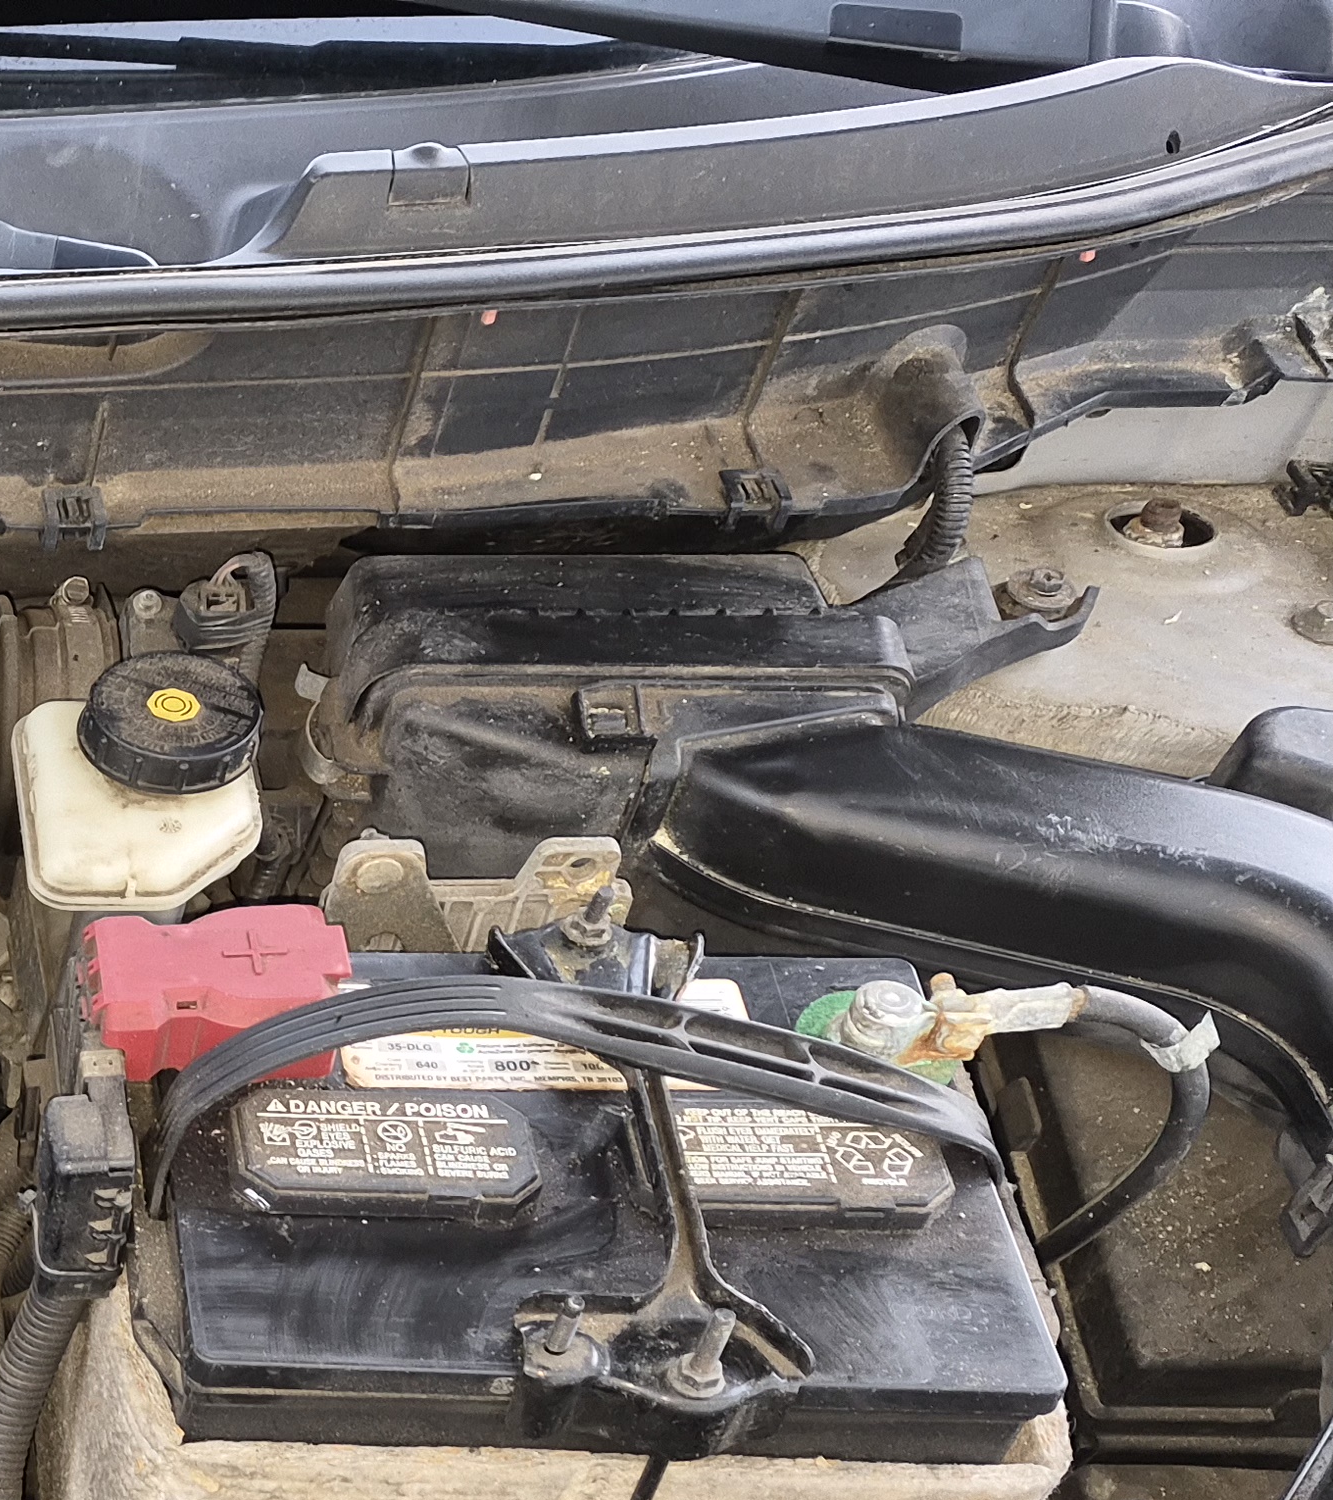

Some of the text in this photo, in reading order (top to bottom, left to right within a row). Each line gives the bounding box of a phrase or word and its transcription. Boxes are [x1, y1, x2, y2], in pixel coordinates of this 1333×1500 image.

[416, 1061, 438, 1070] 640
[494, 1060, 531, 1072] 800
[289, 1099, 490, 1119] DANGER POISON
[320, 1123, 360, 1132] SHIELD
[322, 1132, 351, 1140] EYES
[295, 1139, 356, 1150] EXPLOSIVE
[386, 1143, 407, 1153] NO
[702, 1143, 794, 1153] MEDICAL HELP FAST
[297, 1148, 335, 1158] GASES
[432, 1143, 517, 1157] SULFURIC ACID
